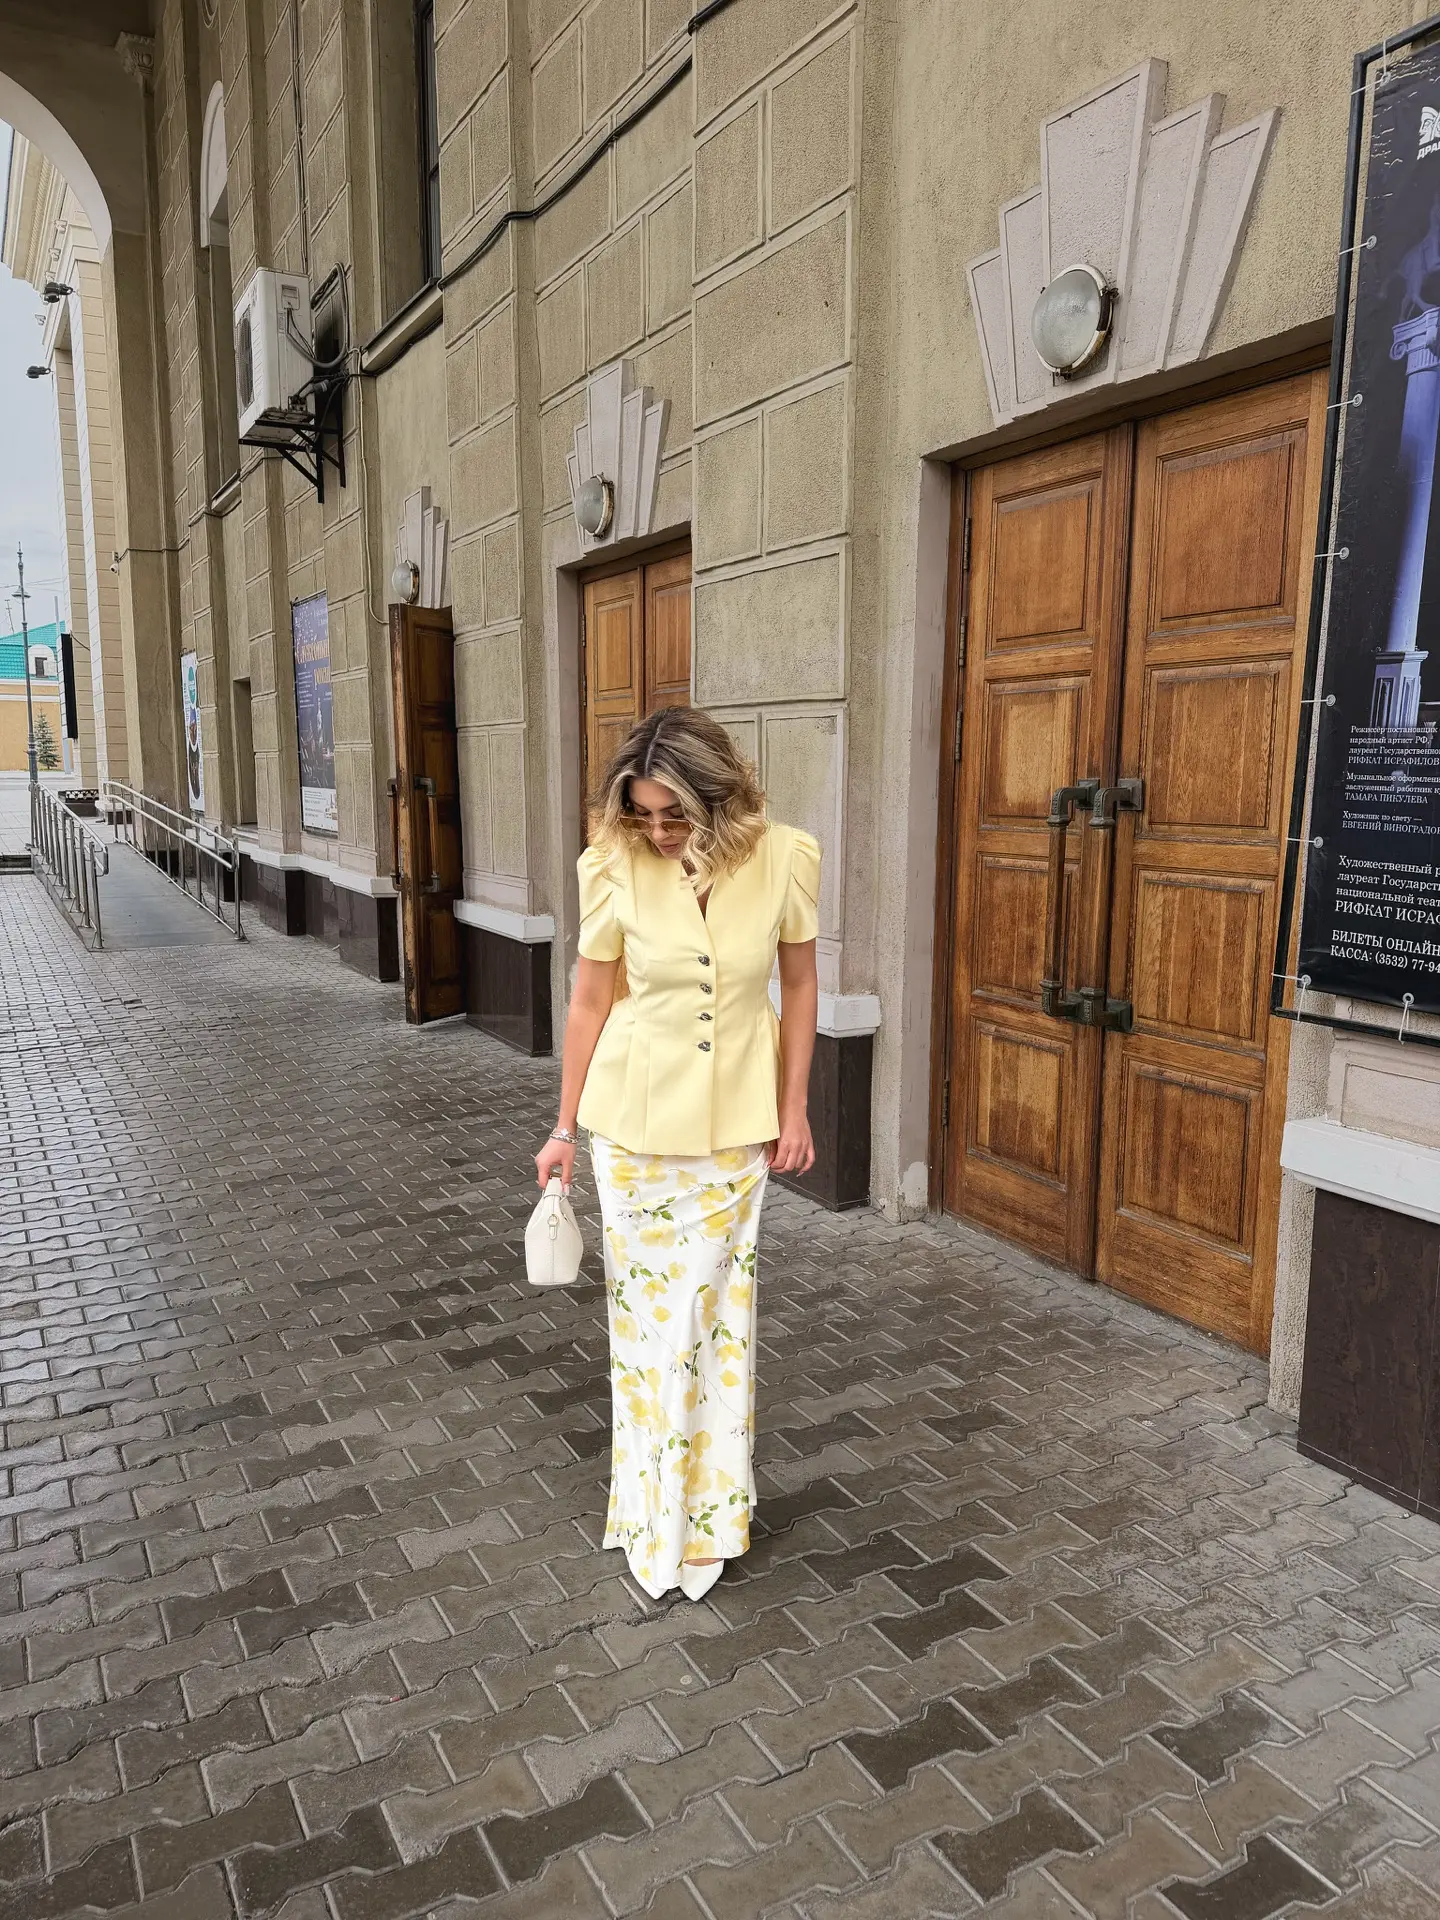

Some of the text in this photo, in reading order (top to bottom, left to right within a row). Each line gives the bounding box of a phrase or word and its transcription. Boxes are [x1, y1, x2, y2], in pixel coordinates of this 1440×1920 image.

[1350, 736, 1386, 745] народный
[1348, 746, 1440, 756] лауреат Государственно
[1348, 756, 1440, 765] РИФКАТ ИСРАФИЛОВ
[1346, 772, 1396, 782] Музыкальное
[1345, 784, 1395, 792] заслуженный
[1396, 784, 1433, 794] работник
[1345, 792, 1428, 804] ТАМАРА ПИКУЛЕВА
[1343, 810, 1380, 820] Художник
[1392, 815, 1412, 824] свету
[1342, 820, 1381, 830] ЕВГЕНИЙ
[1339, 855, 1432, 874] Художественный
[1337, 873, 1380, 884] лауреат
[1336, 887, 1414, 904] национальной
[1335, 900, 1393, 919] РИФКАТ
[1332, 929, 1440, 957] БИЛЕТЫ ОНЛАЙН
[1330, 945, 1373, 962] КАССА:
[1375, 951, 1408, 969] (3532)
